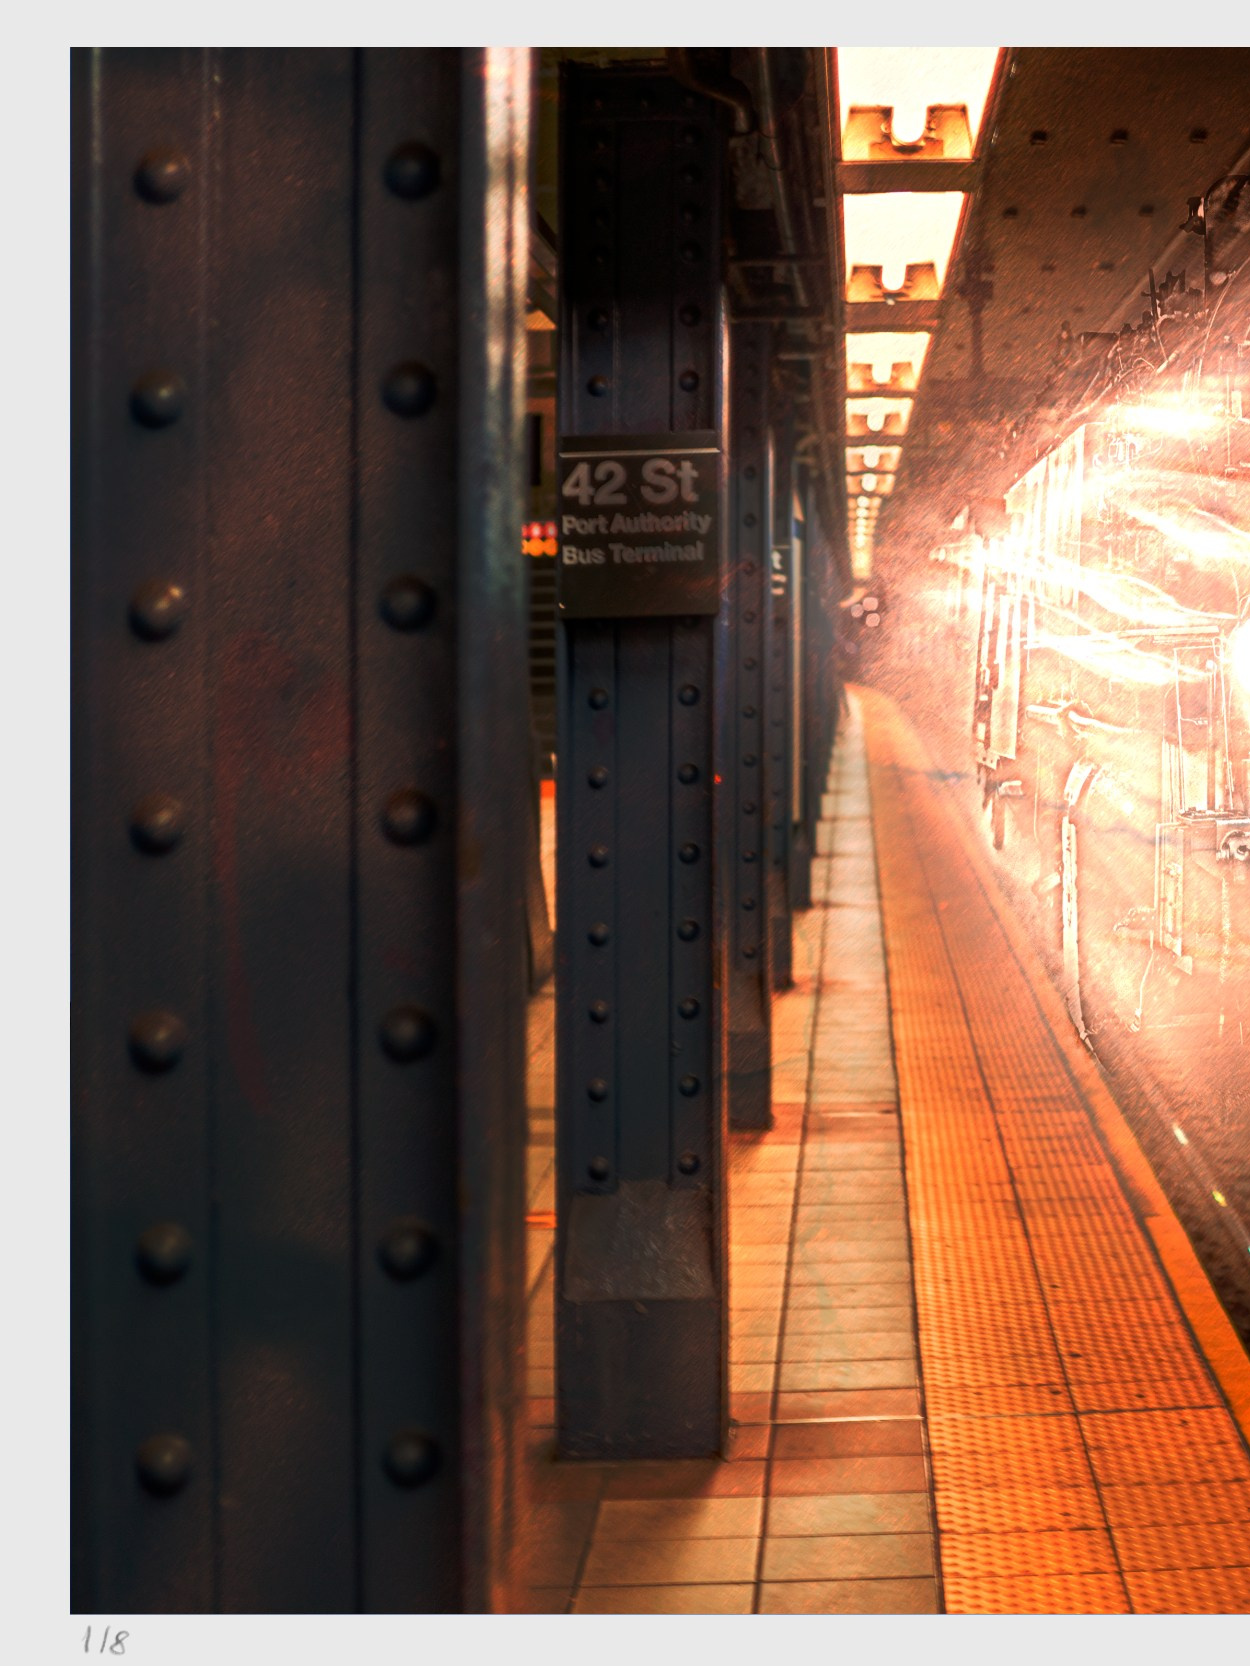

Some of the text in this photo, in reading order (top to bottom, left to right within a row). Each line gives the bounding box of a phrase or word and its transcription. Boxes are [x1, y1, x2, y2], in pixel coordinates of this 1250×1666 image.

[561, 458, 699, 505] 42 St
[561, 509, 712, 535] Port Authority
[561, 540, 705, 565] Bus Terminal
